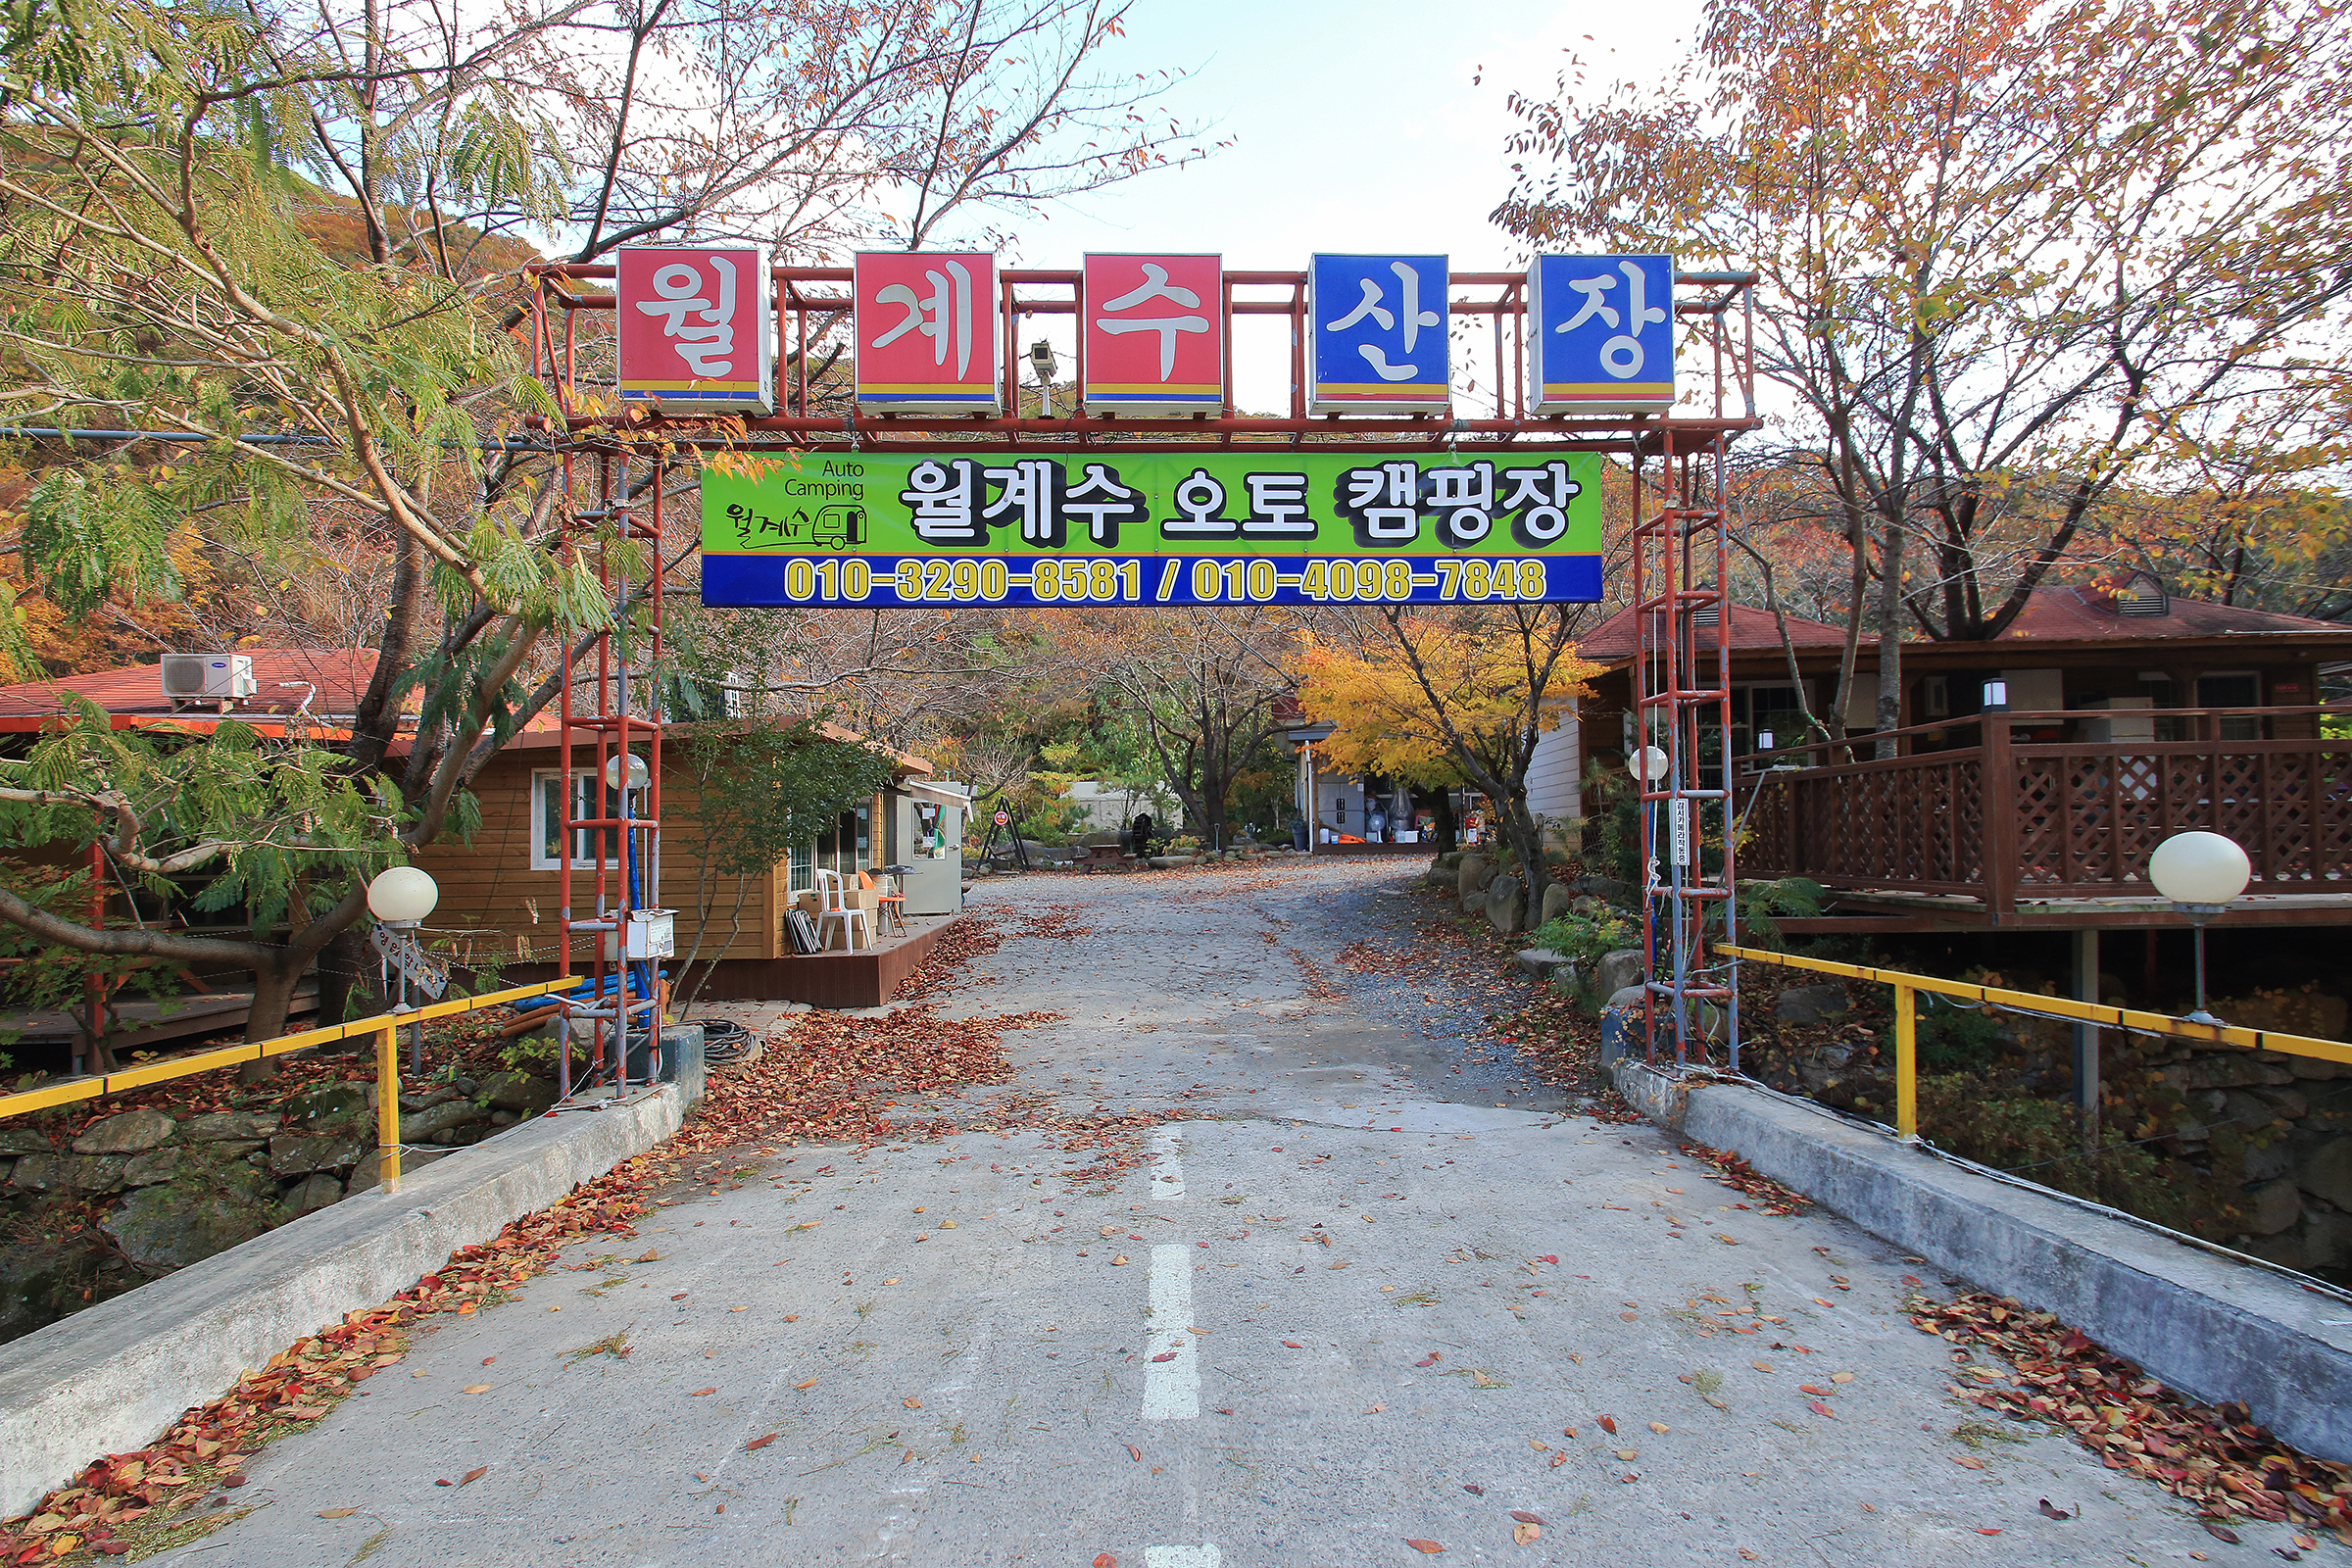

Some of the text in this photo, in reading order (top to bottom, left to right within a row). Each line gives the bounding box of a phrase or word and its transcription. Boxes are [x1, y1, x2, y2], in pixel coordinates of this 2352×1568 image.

[784, 478, 864, 501] Camping
[821, 460, 865, 477] Auto
[725, 503, 812, 546] 월계수
[900, 460, 1582, 546] 월계수 오토 캠핑장
[784, 557, 1142, 602] 010-3290-8581
[1192, 558, 1547, 603] 010-4098-7848
